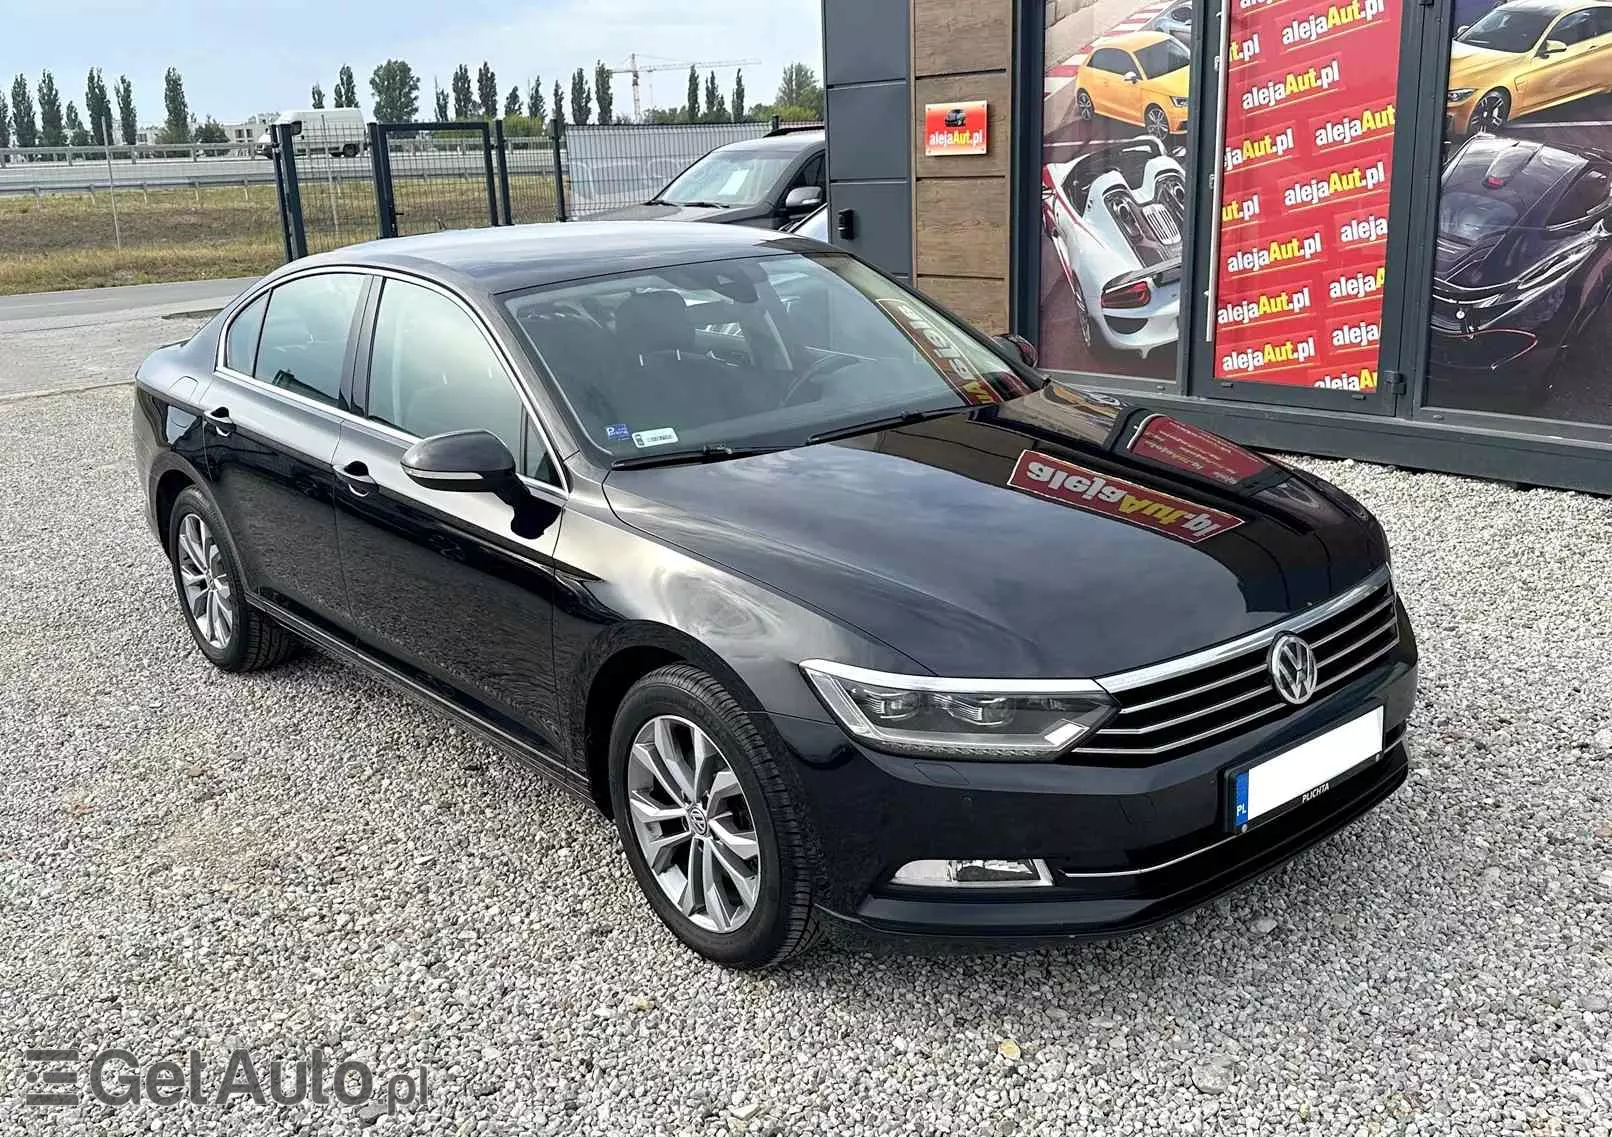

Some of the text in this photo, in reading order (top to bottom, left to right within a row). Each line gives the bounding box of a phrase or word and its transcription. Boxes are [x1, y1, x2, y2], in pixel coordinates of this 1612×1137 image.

[1282, 0, 1384, 44] alejaAut.pl
[1242, 60, 1340, 110] alejaAut.pl
[929, 129, 983, 147] alejaAut.pl
[1224, 127, 1294, 171] jaAut.pl
[1284, 160, 1385, 206] alejaAut.pl
[1340, 215, 1388, 242] aleja
[1227, 233, 1322, 272] alejaAut.pl
[1217, 288, 1311, 324] alejaAut.pl
[1222, 337, 1316, 372] alejaAut.pl
[1236, 803, 1247, 816] PL
[1302, 782, 1330, 803] PLICHTA
